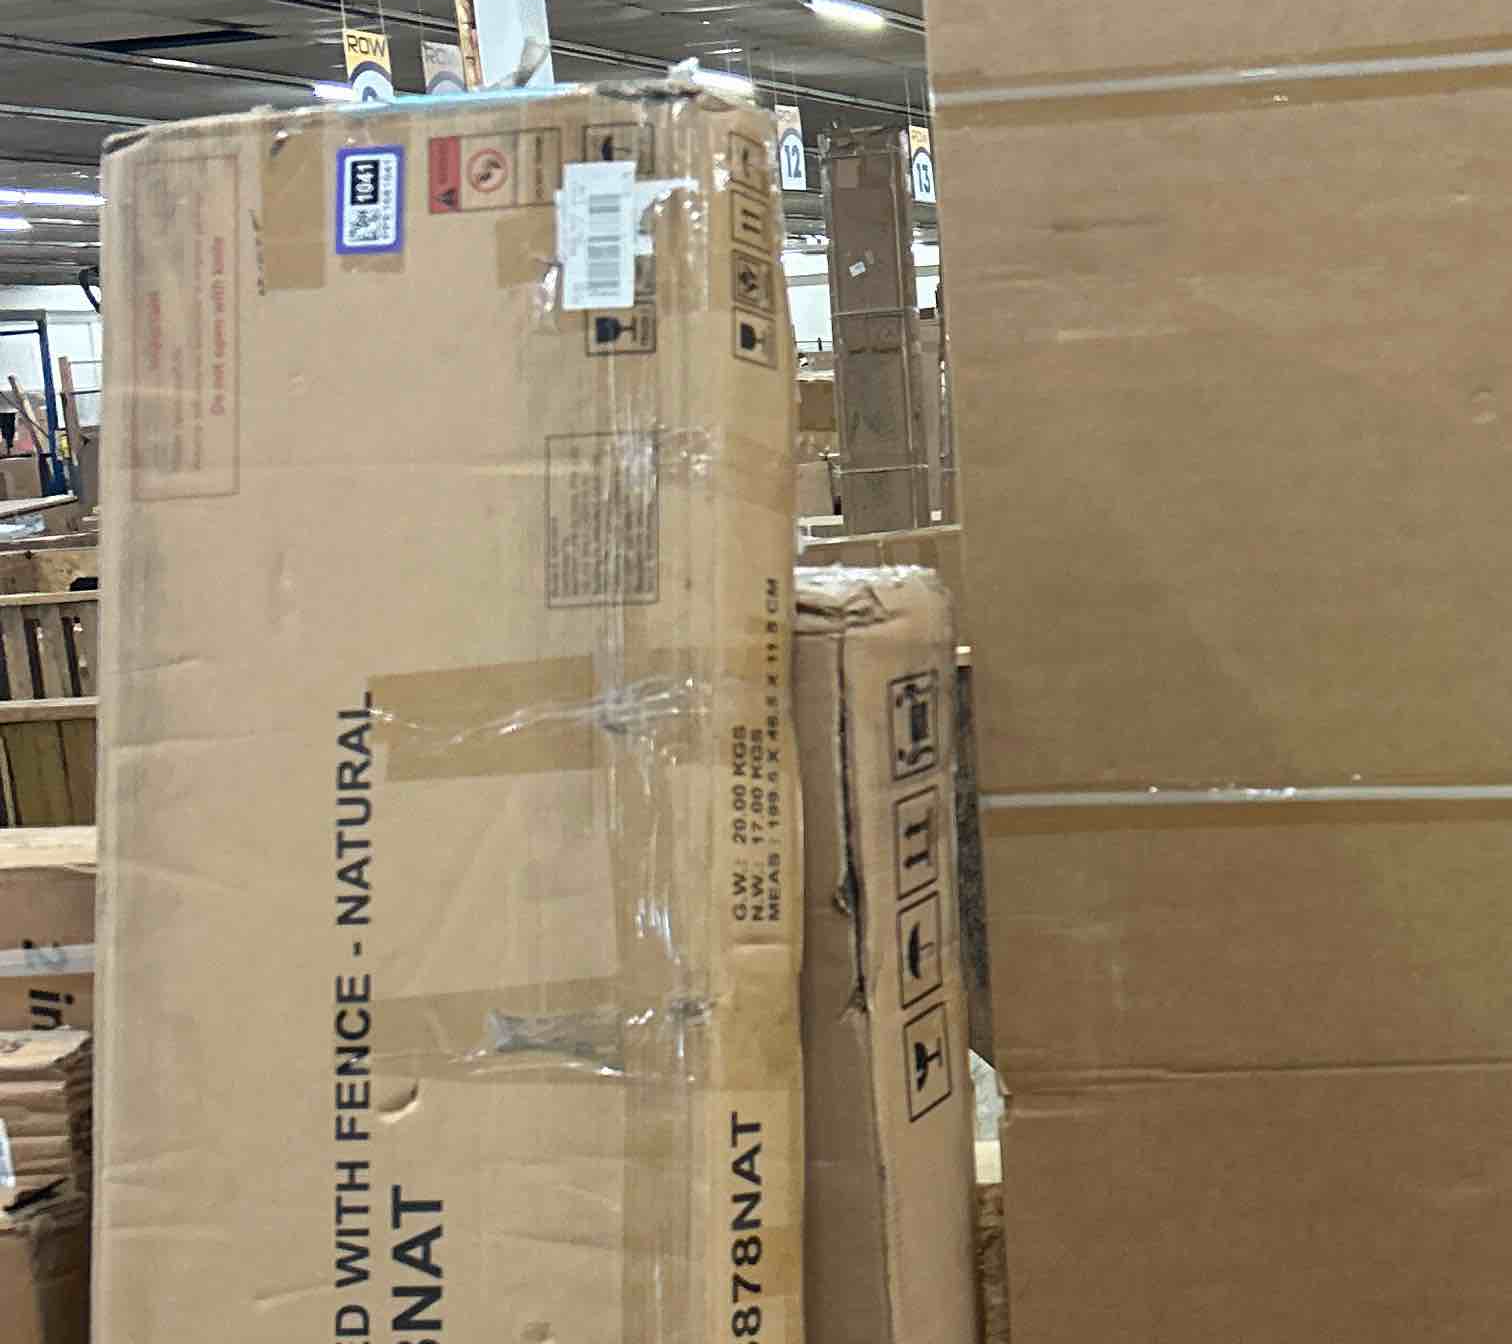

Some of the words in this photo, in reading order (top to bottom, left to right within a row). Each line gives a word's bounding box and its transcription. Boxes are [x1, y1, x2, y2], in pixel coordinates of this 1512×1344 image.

[346, 34, 386, 57] ROW
[356, 164, 374, 202] 1041
[783, 144, 802, 179] 12
[916, 162, 931, 194] 13
[766, 578, 778, 615] CM
[733, 726, 746, 776] KGS
[751, 729, 763, 779] KGS
[336, 691, 371, 926] NATURAL
[732, 784, 747, 844] 20.00
[752, 787, 764, 844] 17.00
[768, 853, 780, 921] MEAS
[336, 974, 370, 1141] FENCE
[336, 1161, 370, 1286] WITH
